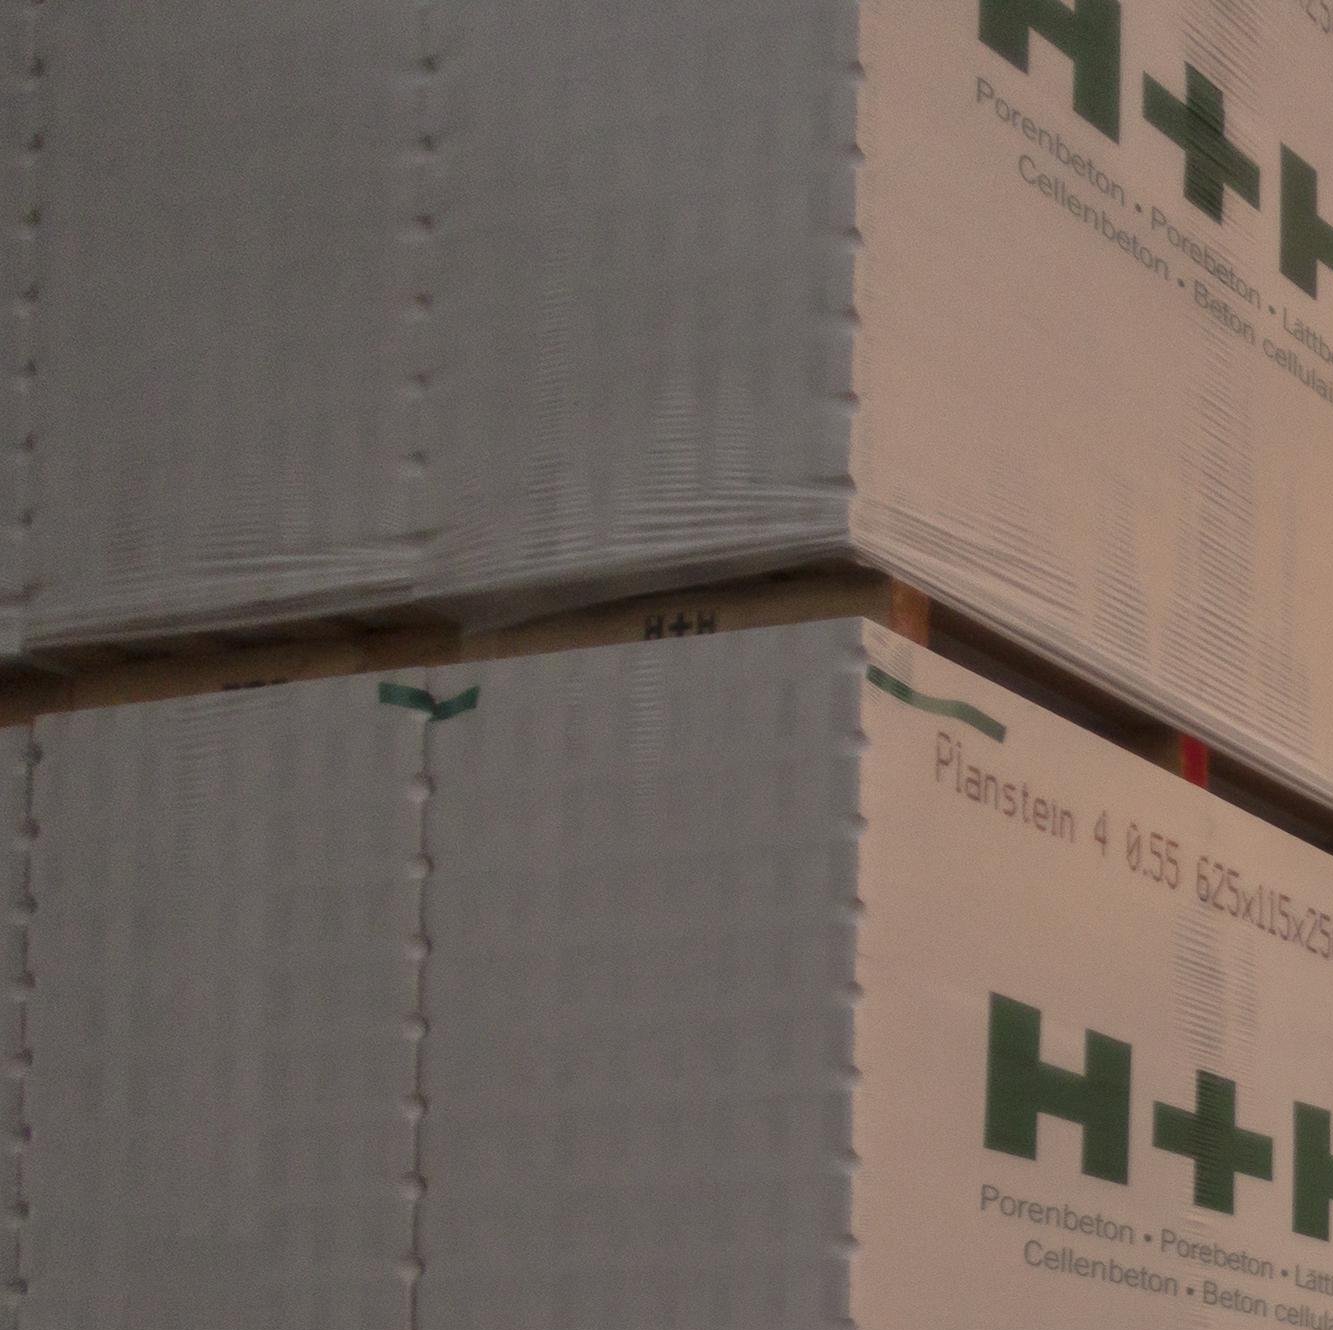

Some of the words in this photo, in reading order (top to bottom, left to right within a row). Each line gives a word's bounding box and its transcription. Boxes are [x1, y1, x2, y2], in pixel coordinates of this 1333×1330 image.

[975, 76, 1127, 208] Porenbeton
[1151, 206, 1261, 306] Porebeton
[1017, 154, 1170, 280] Cellenbeton
[1193, 283, 1255, 345] Beton
[935, 731, 1075, 844] Planstein
[1093, 809, 1108, 857] 4
[1126, 823, 1180, 890] 0.55
[980, 1183, 1134, 1245] Porenbeton
[1161, 1229, 1274, 1279] Porebeton
[1024, 1240, 1178, 1297] Cellenbeton
[1203, 1281, 1267, 1318] Beton
